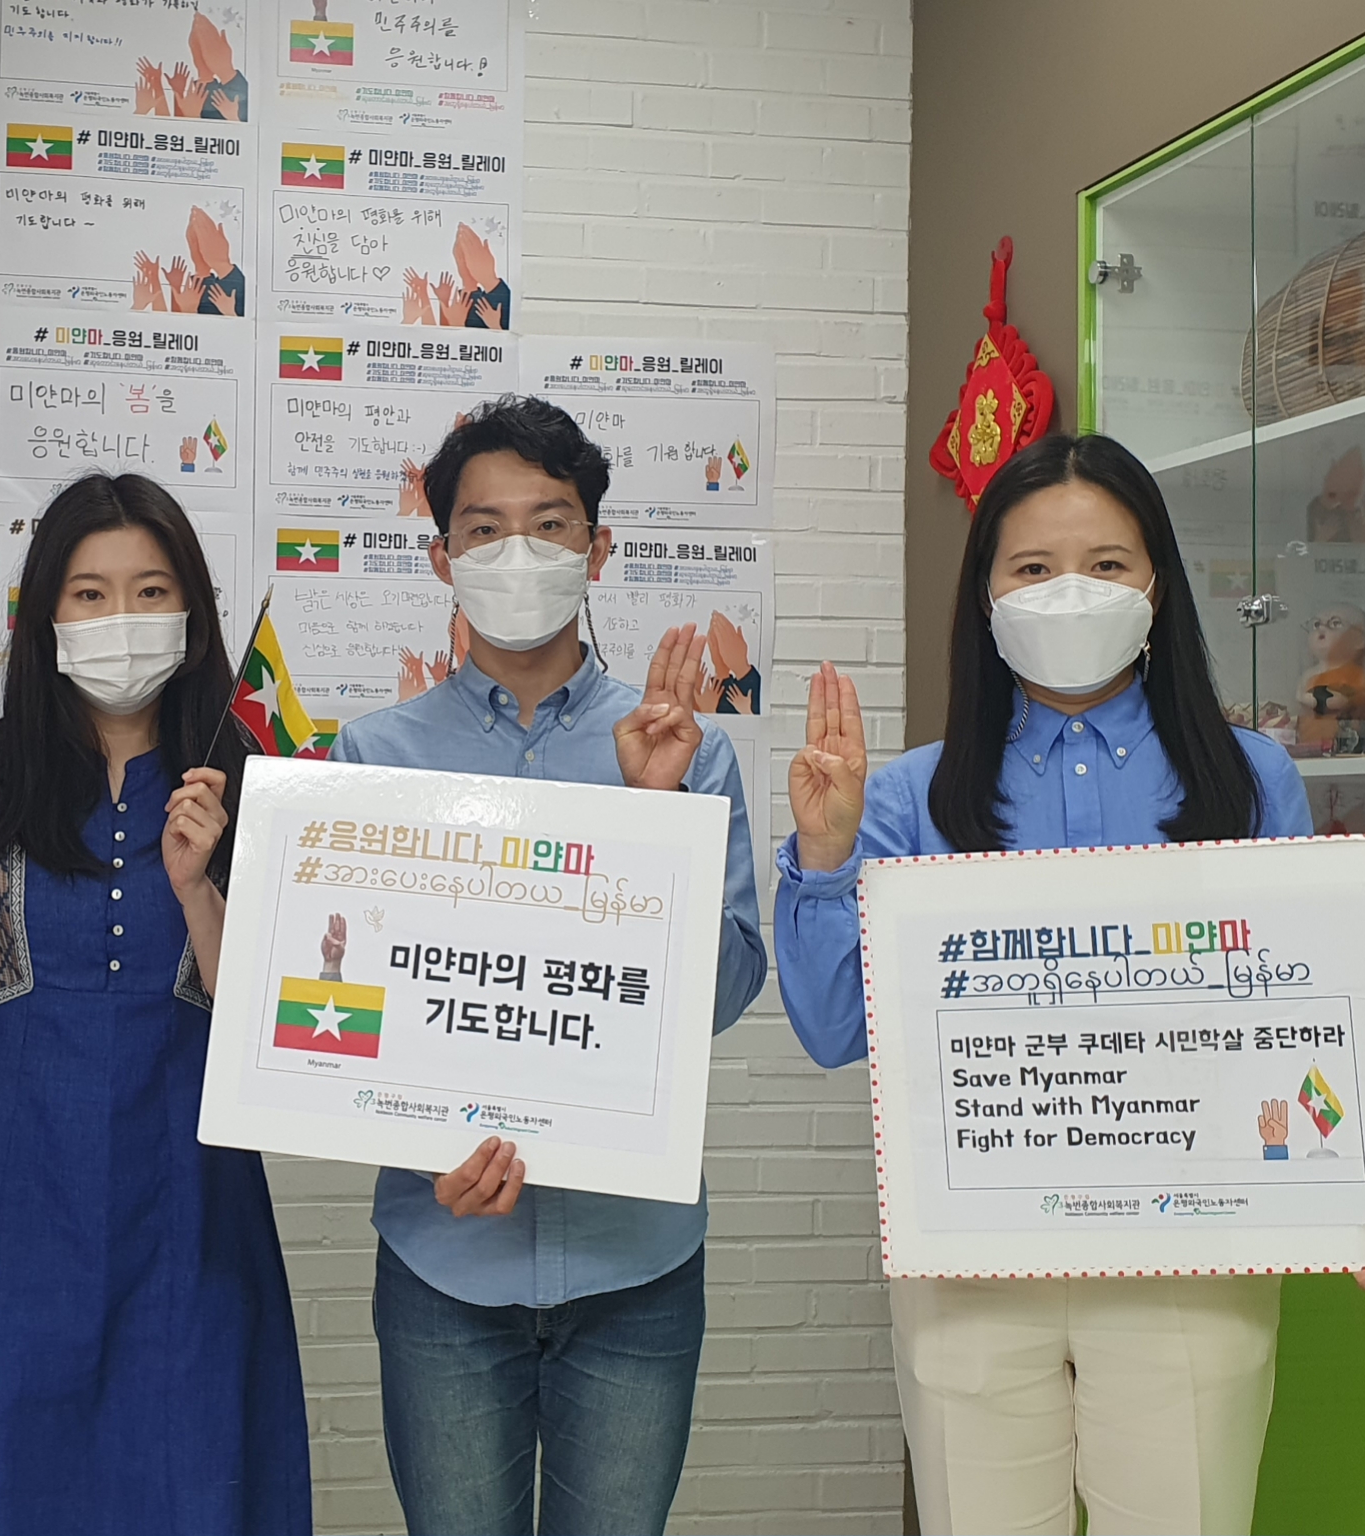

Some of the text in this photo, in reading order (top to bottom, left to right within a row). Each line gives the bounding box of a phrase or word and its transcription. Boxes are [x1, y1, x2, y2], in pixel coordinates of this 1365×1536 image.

[297, 819, 595, 876] #응원합니다_미얀마
[938, 919, 1252, 962] #함께합니다_미얀마
[390, 944, 650, 1005] 미얀마의 평화를
[426, 999, 600, 1050] 기도합니다.
[951, 1025, 1345, 1058] 미얀마 군부 쿠데타 시민학살 중단하라
[307, 1058, 342, 1071] Myanmar
[953, 1067, 1127, 1092] Save Myanmar
[955, 1095, 1200, 1121] Stand with Myanmar
[957, 1127, 1196, 1152] Fight for Democracy
